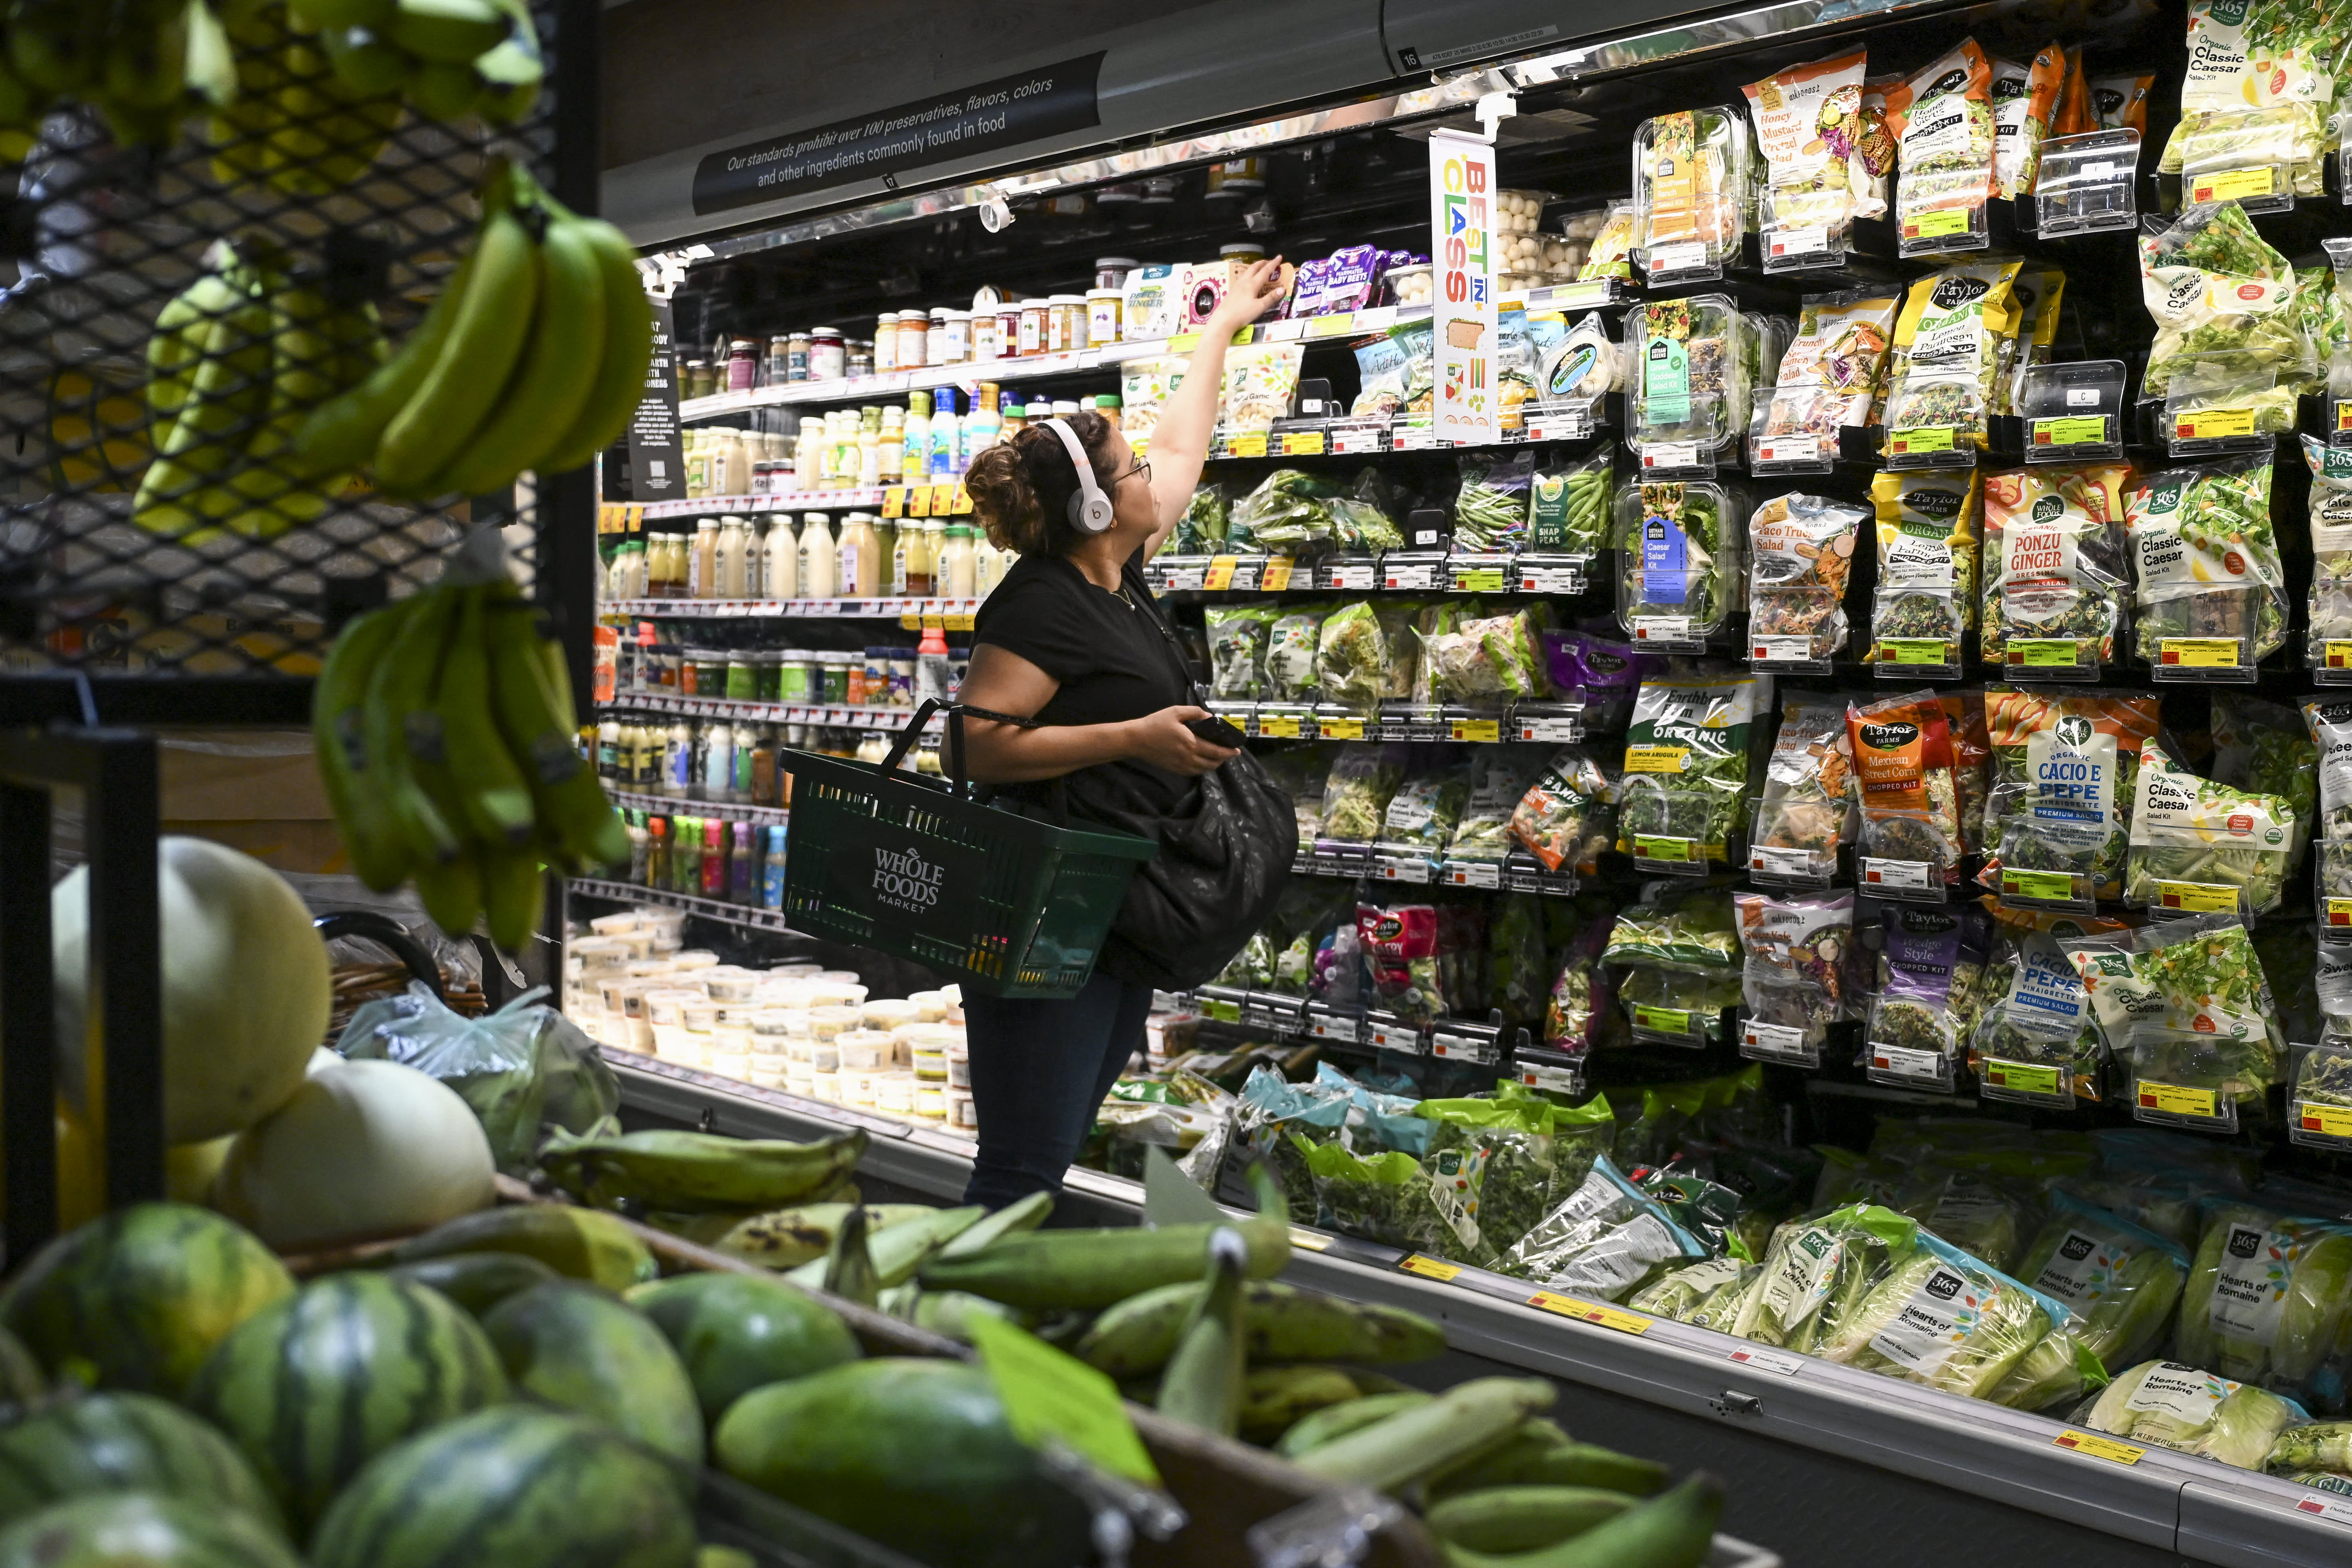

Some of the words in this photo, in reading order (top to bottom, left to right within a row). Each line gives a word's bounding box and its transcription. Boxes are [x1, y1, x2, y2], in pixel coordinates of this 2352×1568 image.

[2215, 0, 2245, 15] 365
[2199, 34, 2232, 51] Organic
[1404, 53, 1417, 66] 16
[2195, 46, 2245, 63] Classic
[2191, 60, 2241, 73] Caesar
[1914, 99, 1946, 119] Honey
[728, 157, 745, 171] Our
[747, 143, 794, 167] standards
[795, 131, 838, 158] prohibit
[838, 128, 862, 143] over
[863, 120, 884, 137] 100
[884, 102, 962, 136] preservatives,
[966, 90, 1010, 112] flavors,
[1014, 79, 1053, 99] colors
[1761, 112, 1792, 125] Honey
[1914, 109, 1945, 126] Citrus
[1944, 116, 1959, 125] KIT
[1762, 120, 1801, 140] Mustard
[758, 168, 775, 187] and
[779, 164, 805, 182] other
[807, 150, 865, 177] ingredients
[868, 133, 925, 161] commonly
[927, 123, 961, 147] found
[964, 121, 975, 138] in
[978, 112, 1005, 134] food
[1764, 137, 1797, 153] Pretzel
[887, 178, 894, 187] 17
[1657, 178, 1690, 188] Southwest
[1657, 189, 1677, 198] Ranch
[1466, 161, 1488, 274] BEST
[1443, 159, 1467, 303] CLASS
[1328, 275, 1347, 286] BABY
[1347, 271, 1368, 283] BEETS
[1336, 268, 1363, 276] MARINATED
[1939, 284, 1985, 298] Taylor
[2167, 286, 2203, 308] Caesar
[1931, 325, 1965, 341] Lemon
[1793, 336, 1827, 347] Crunchy
[1919, 334, 1973, 351] Parmesan
[2329, 453, 2352, 467] 365
[1913, 492, 1958, 504] Taylor
[2152, 489, 2176, 506] 365
[2325, 496, 2350, 508] Kale
[1539, 528, 1559, 536] SNAP
[2140, 528, 2167, 540] Organic
[1756, 539, 1784, 551] Salad
[2015, 533, 2061, 553] PONZU
[2142, 535, 2183, 553] Classic
[2011, 551, 2061, 571] GINGER
[2143, 549, 2183, 567] Caesar
[2016, 569, 2056, 578] DRESSING
[2323, 706, 2350, 717] 365
[1653, 726, 1726, 744] ORGANIC
[1866, 723, 1918, 736] Taylor
[1869, 756, 1908, 767] Mexican
[2050, 752, 2091, 762] ORGANIC
[1864, 769, 1891, 779] Street
[1892, 767, 1917, 777] Corn
[2038, 763, 2087, 781] CACIO
[2091, 764, 2101, 782] E
[2151, 773, 2184, 786] Organic
[1867, 782, 1901, 791] CHOPPED
[2040, 783, 2100, 801] PEPE
[2148, 783, 2196, 800] Classic
[2039, 799, 2099, 809] VINAIGRETTE
[2147, 797, 2192, 811] Caesar
[1390, 808, 1410, 817] Brussels
[876, 848, 944, 885] WHOLE
[872, 869, 938, 905] FOODS
[878, 893, 926, 914] MARKET
[1907, 911, 1950, 924] Taylor
[1903, 938, 1942, 950] Wedge
[1904, 948, 1934, 961] Style
[1891, 962, 1929, 972] CHOPPED
[2100, 958, 2126, 970] 365
[2024, 968, 2082, 993] PEPE
[2022, 984, 2076, 1001] VINAIGRETTE
[2119, 990, 2162, 1005] Classic
[2018, 995, 2049, 1007] PREMIUM
[2051, 1001, 2075, 1012] SALAD
[2125, 1003, 2165, 1013] Caesar
[2070, 1240, 2088, 1254] 365
[2236, 1234, 2257, 1250] 365
[1931, 1276, 1958, 1294] 365
[2044, 1268, 2072, 1286] Hearts
[2073, 1282, 2086, 1291] of
[2220, 1273, 2253, 1290] Hearts
[2256, 1281, 2268, 1293] of
[2037, 1277, 2075, 1298] Romaine
[2217, 1285, 2260, 1303] Romaine
[1905, 1304, 1940, 1330] Hearts
[1939, 1323, 1951, 1331] of
[1898, 1313, 1938, 1338] Romaine
[1895, 1342, 1902, 1351] de
[1900, 1346, 1921, 1361] romaine
[2149, 1375, 2187, 1386] Hearts
[2144, 1382, 2193, 1395] Romaine
[2160, 1401, 2182, 1413] romaine
